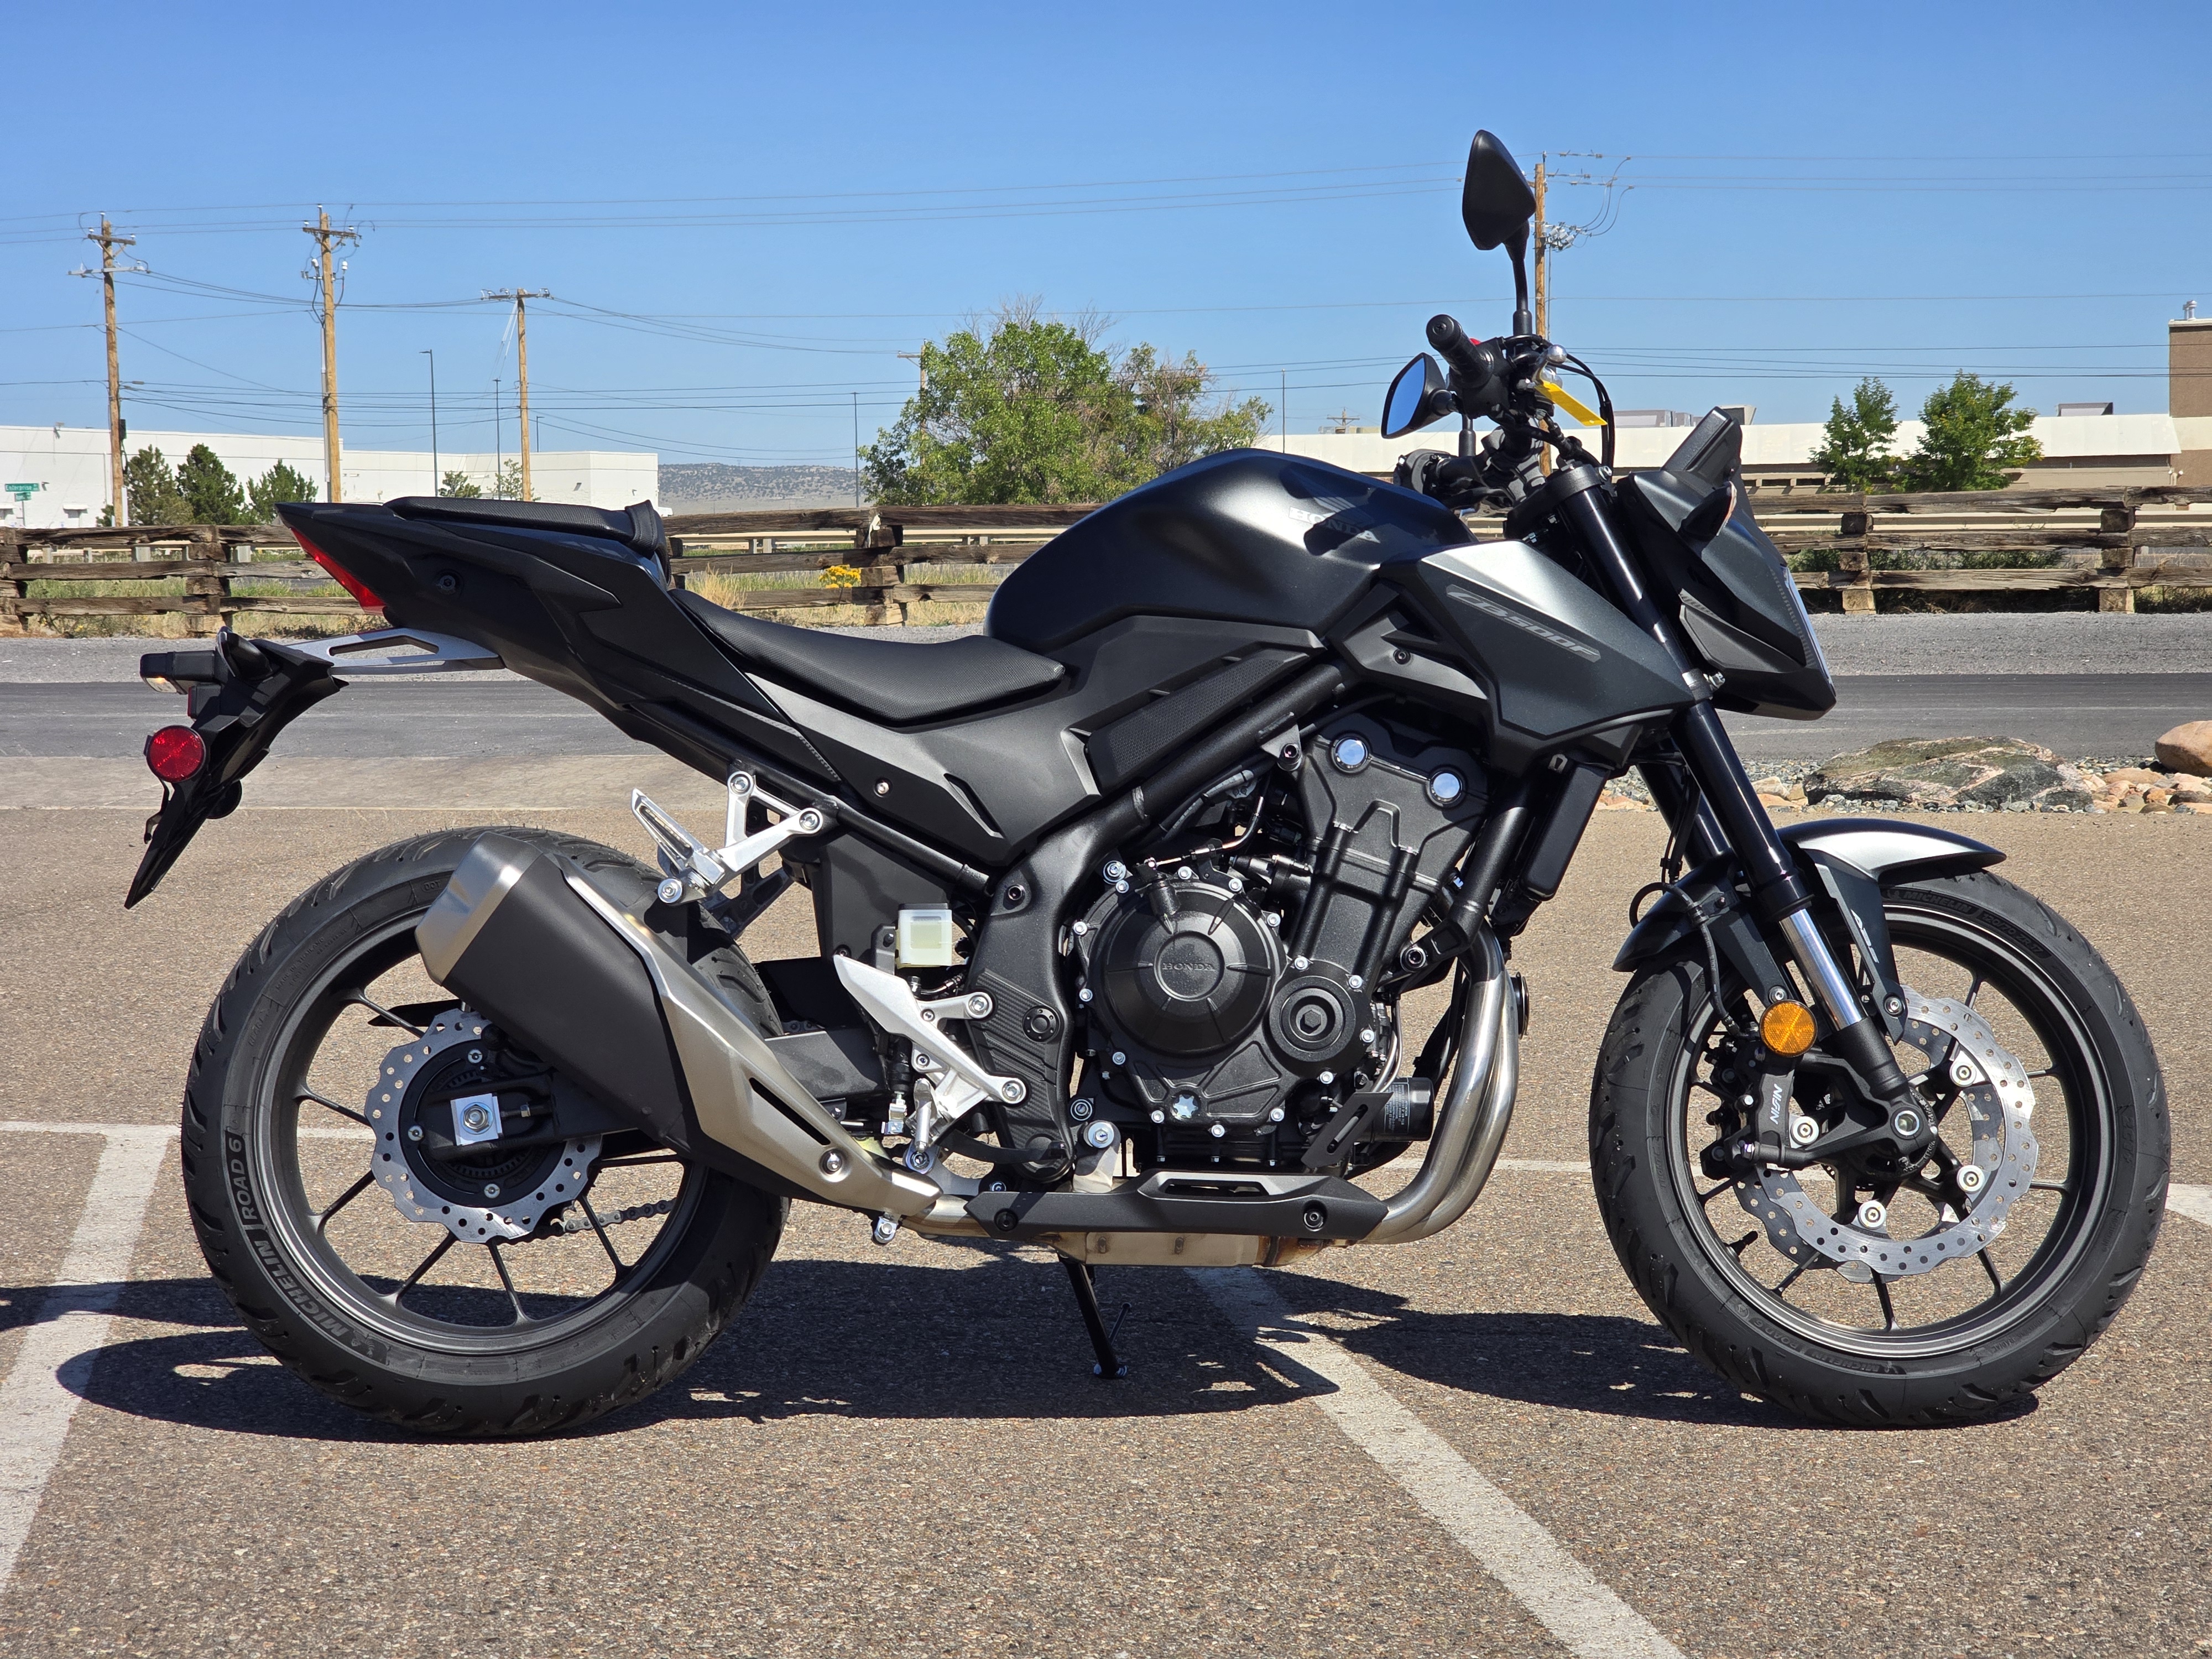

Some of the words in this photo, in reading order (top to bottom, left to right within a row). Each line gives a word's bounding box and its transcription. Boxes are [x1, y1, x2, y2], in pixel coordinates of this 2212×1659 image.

[1291, 507, 1381, 544] HONDA
[1447, 592, 1600, 656] CB500F
[1903, 890, 1972, 914] MICHELIN
[1161, 962, 1215, 972] HONDA
[228, 1136, 243, 1153] 6
[232, 1159, 258, 1221] ROAD
[254, 1239, 349, 1338] MICHELIN
[1752, 1317, 1765, 1329] 6
[1763, 1325, 1800, 1350] ROAD
[1811, 1349, 1879, 1373] MICHELIN
